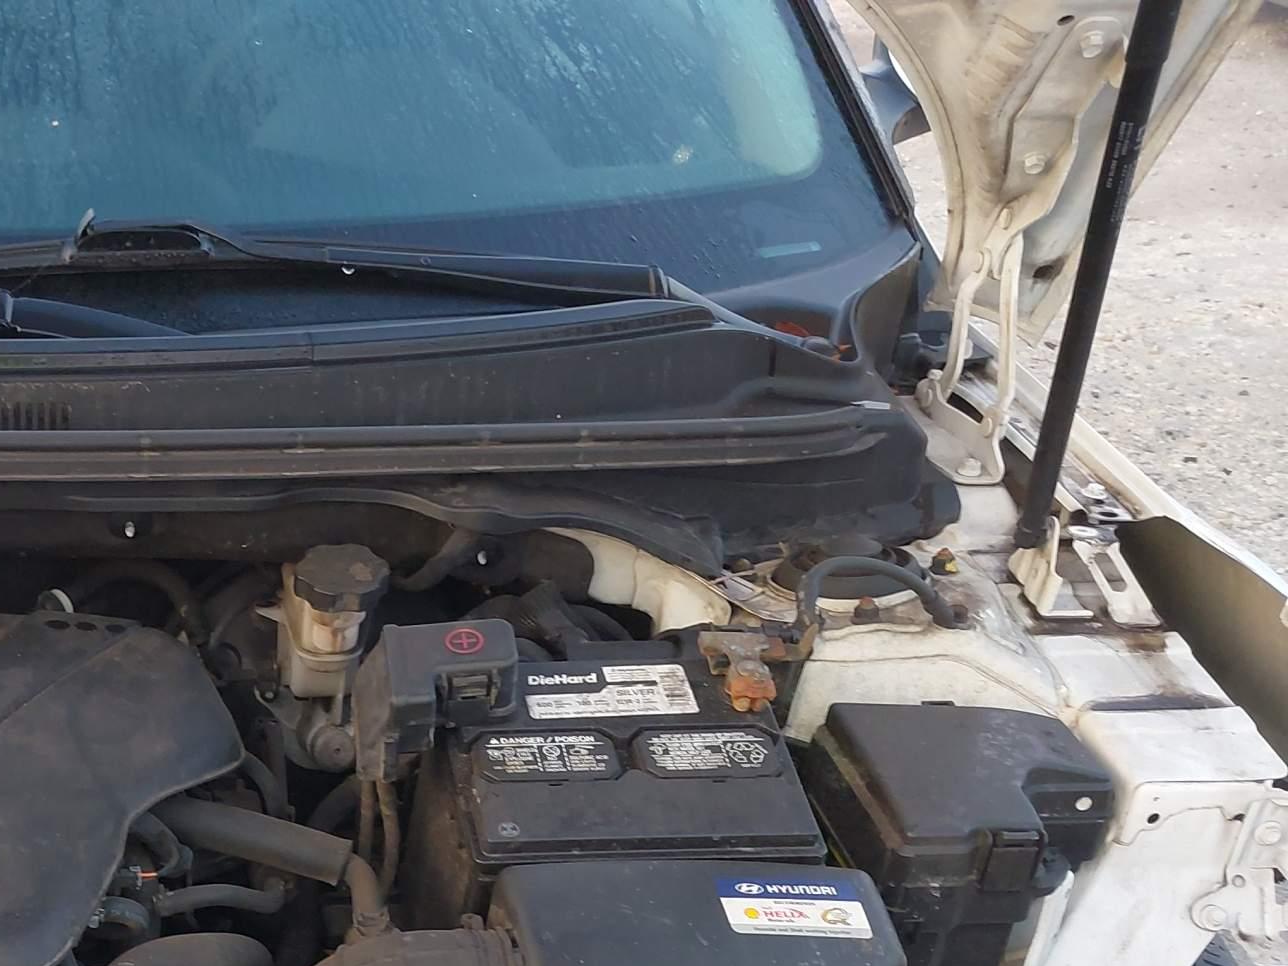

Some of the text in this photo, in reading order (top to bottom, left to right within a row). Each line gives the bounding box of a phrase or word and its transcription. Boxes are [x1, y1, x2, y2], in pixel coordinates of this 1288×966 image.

[527, 673, 598, 686] DieHard
[615, 688, 656, 697] SILVER
[554, 735, 595, 743] POISON
[766, 885, 838, 896] HYUNDAI
